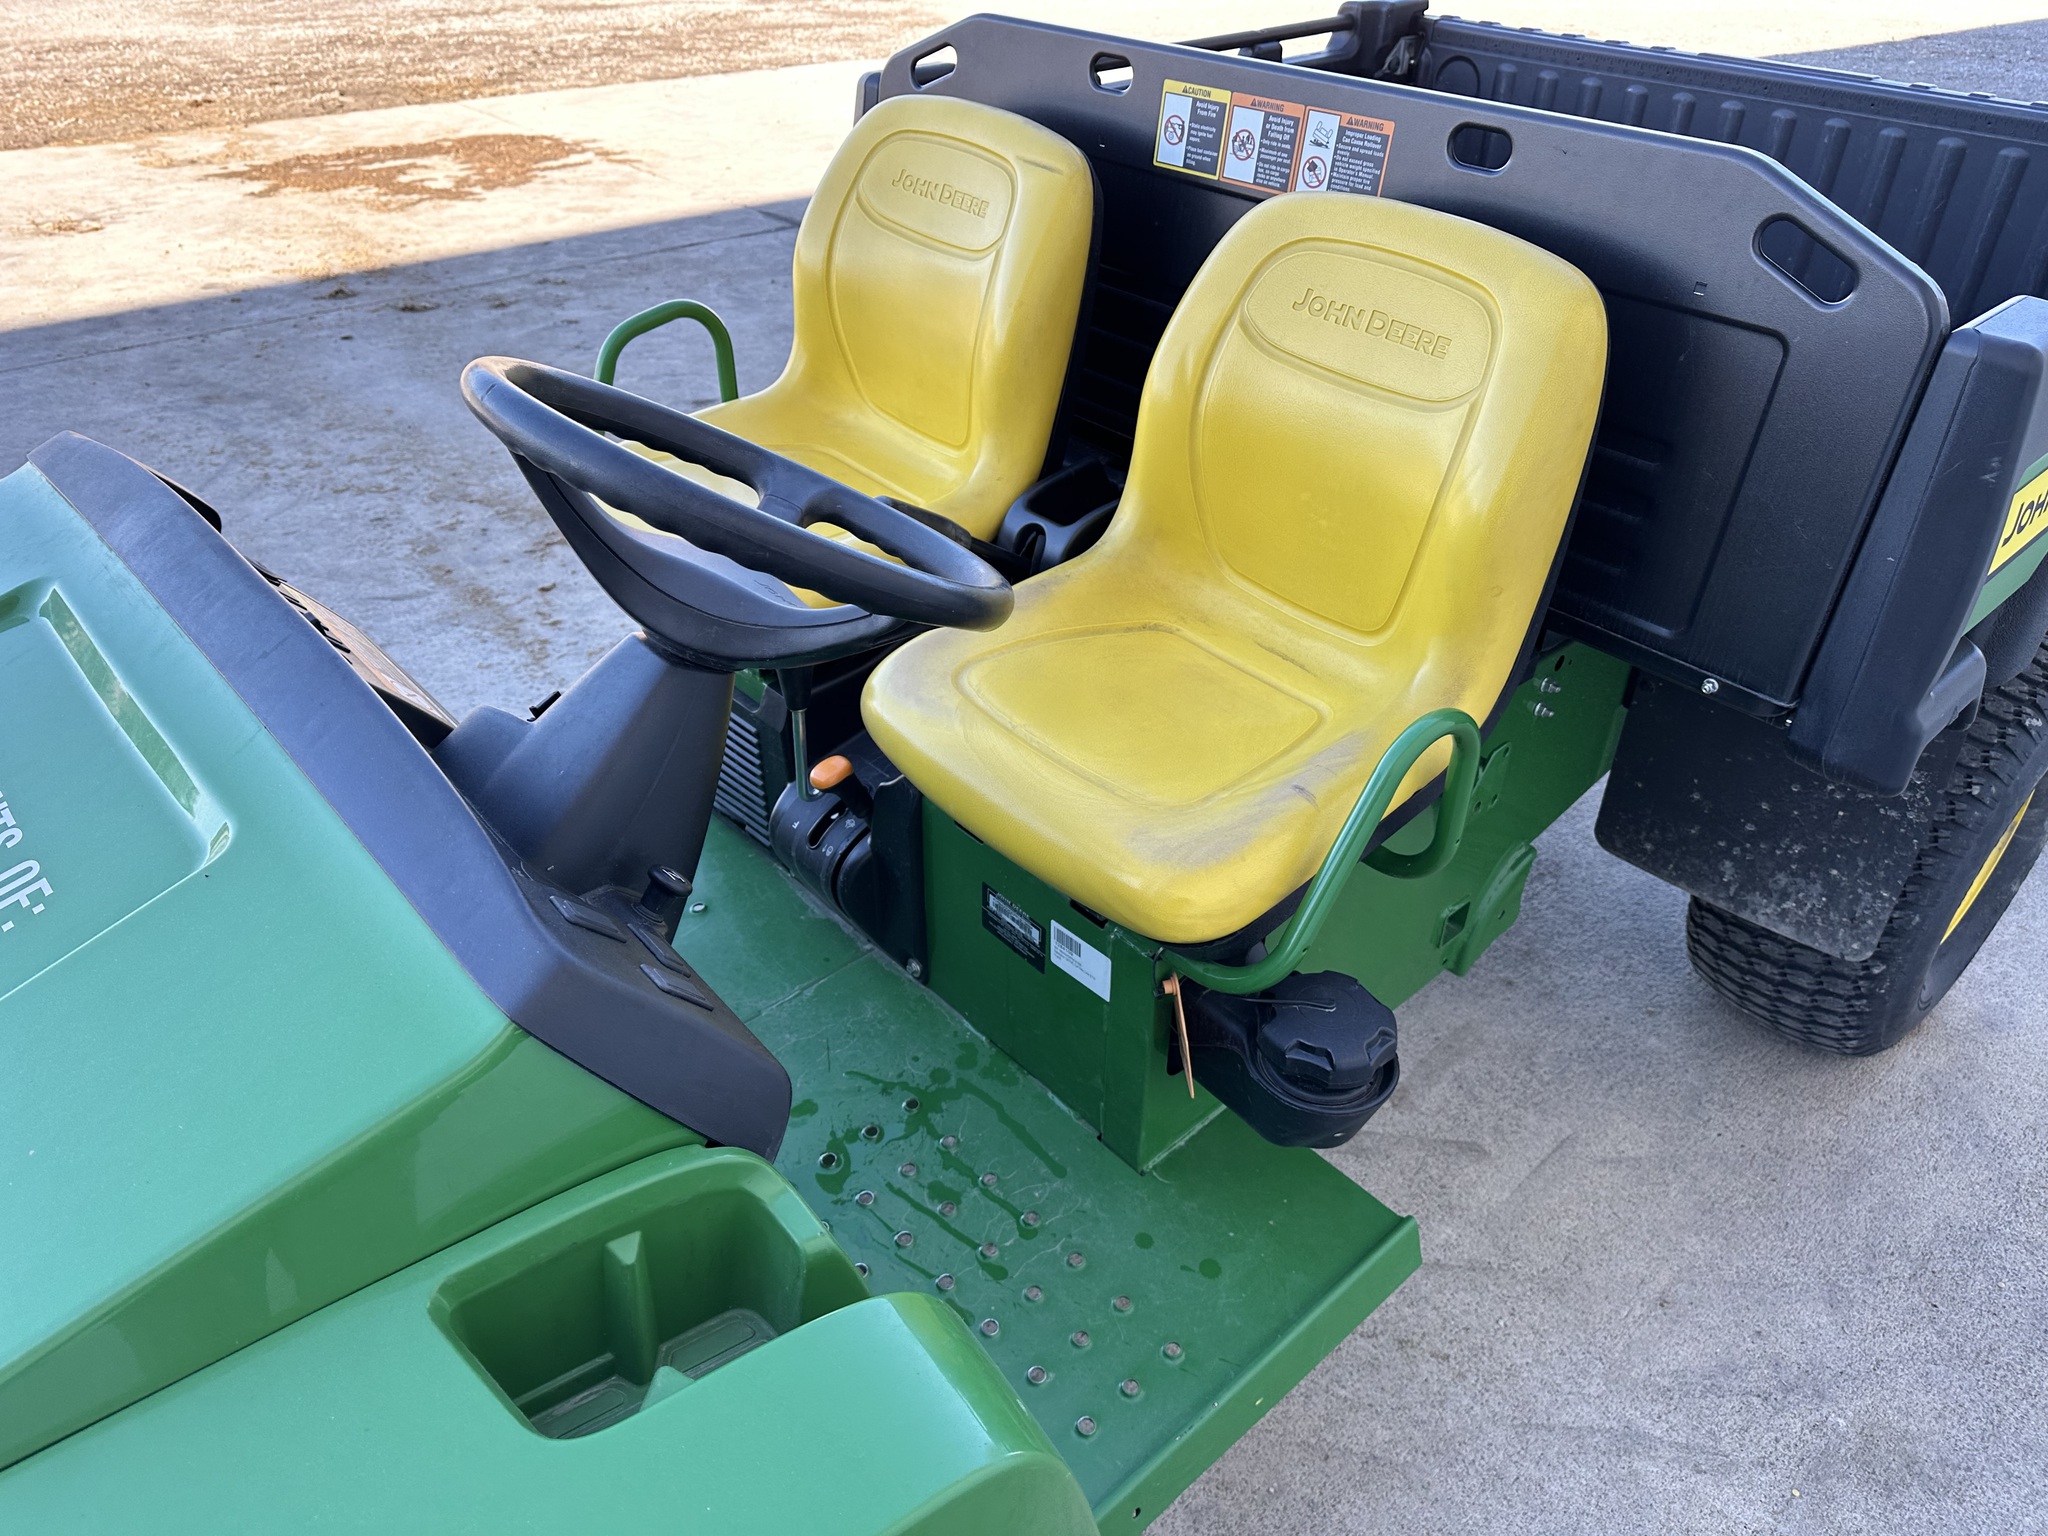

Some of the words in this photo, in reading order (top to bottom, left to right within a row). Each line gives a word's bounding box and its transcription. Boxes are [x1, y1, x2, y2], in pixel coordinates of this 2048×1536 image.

[1187, 87, 1211, 98] CAUTION
[1196, 101, 1207, 109] Avoid
[1207, 103, 1220, 112] Injury
[1257, 100, 1285, 112] WARNING
[1269, 115, 1281, 123] Avoid
[1281, 118, 1294, 127] Injury
[1352, 118, 1384, 131] WARNING
[1271, 124, 1284, 132] Death
[1284, 126, 1294, 134] from
[1268, 131, 1282, 140] Falling
[1345, 130, 1364, 139] Improper
[1364, 134, 1381, 143] Loading
[1351, 138, 1364, 146] Cause
[1364, 141, 1382, 150] Rollover
[1359, 148, 1373, 156] spread
[891, 168, 939, 201] JOHN
[938, 183, 990, 219] DEERE
[1292, 288, 1366, 331] JOHN
[1365, 309, 1452, 360] DEERE
